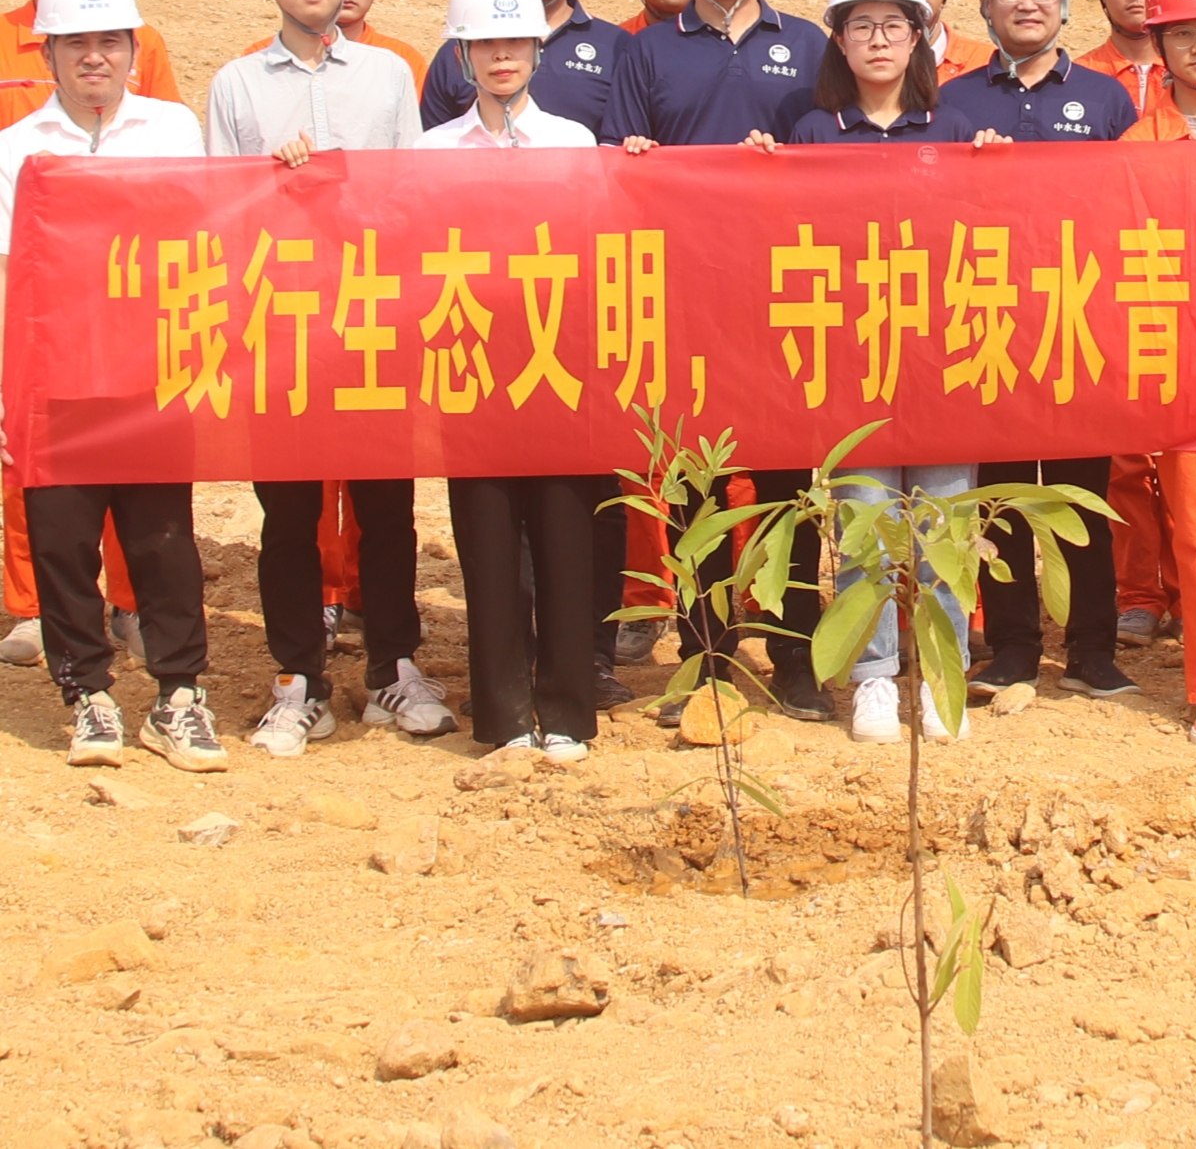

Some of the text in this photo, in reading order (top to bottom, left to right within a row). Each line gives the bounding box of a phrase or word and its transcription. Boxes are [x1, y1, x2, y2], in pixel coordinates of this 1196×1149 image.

[565, 60, 602, 74] 中水北方
[762, 64, 797, 77] 中水北方
[1053, 122, 1092, 135] 中水北方
